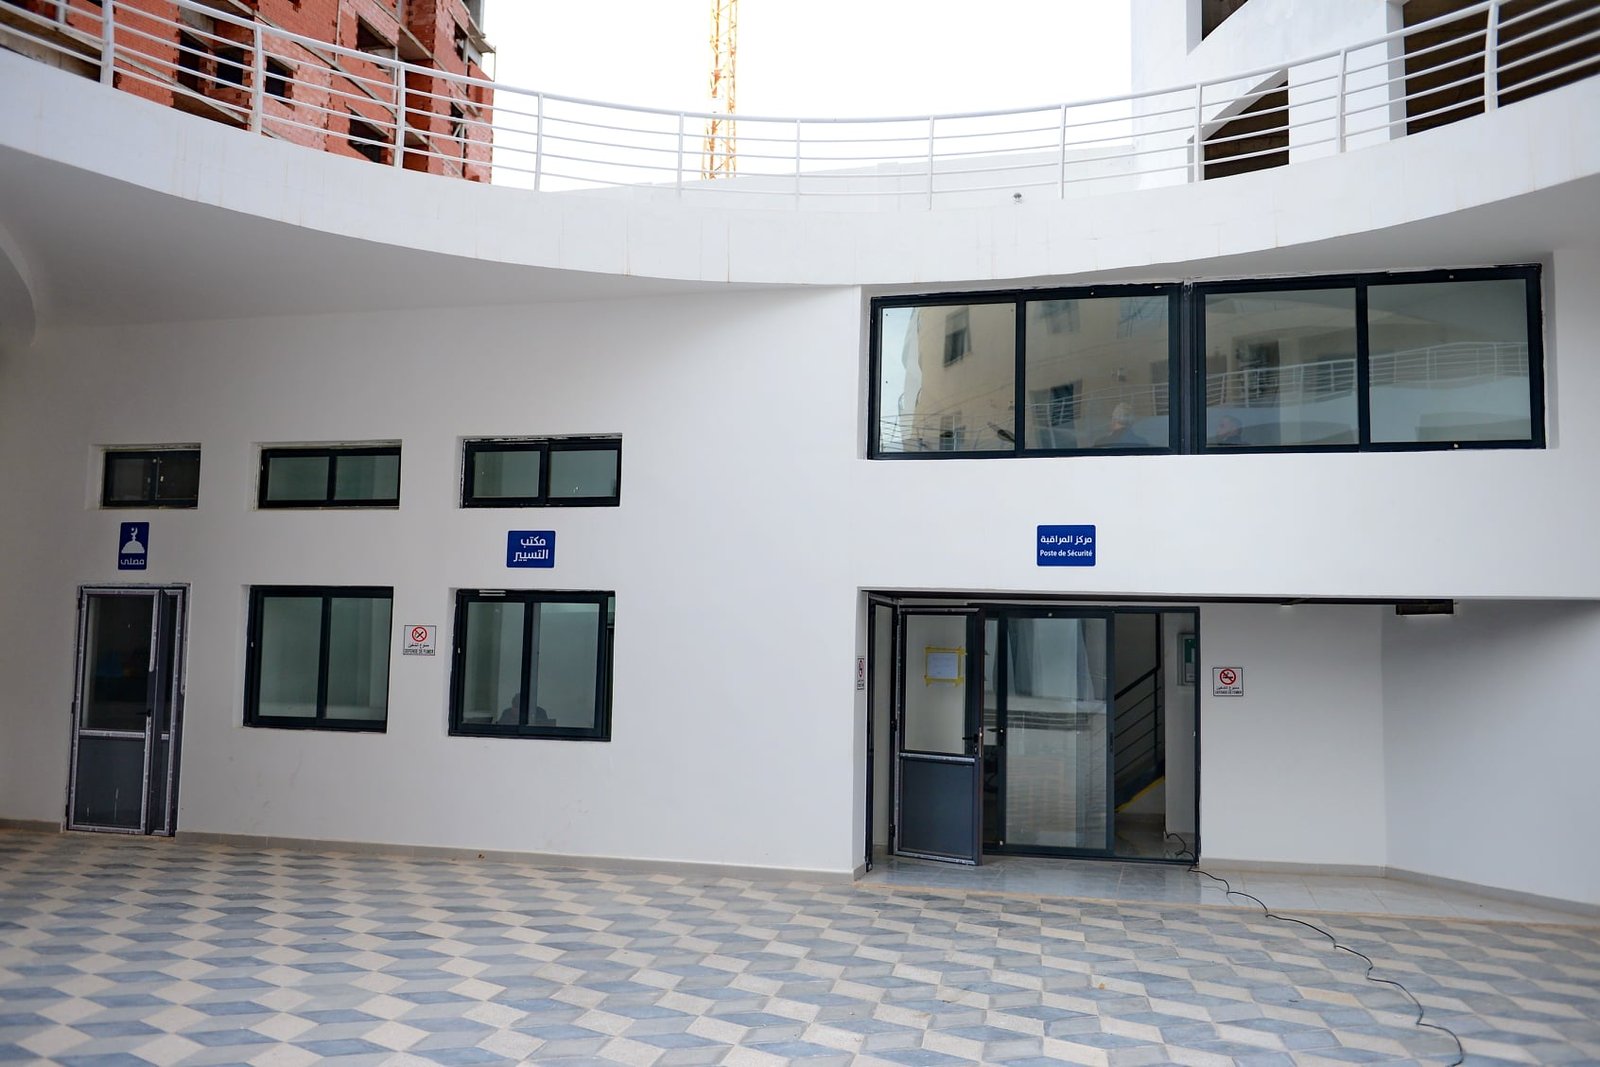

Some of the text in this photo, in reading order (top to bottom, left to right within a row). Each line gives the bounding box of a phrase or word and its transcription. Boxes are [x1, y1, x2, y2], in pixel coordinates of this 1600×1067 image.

[520, 535, 546, 549] مكتب
[1040, 535, 1093, 545] مركز المراقبة
[513, 549, 549, 562] التسيير
[1040, 549, 1093, 557] Poste de Sécurité
